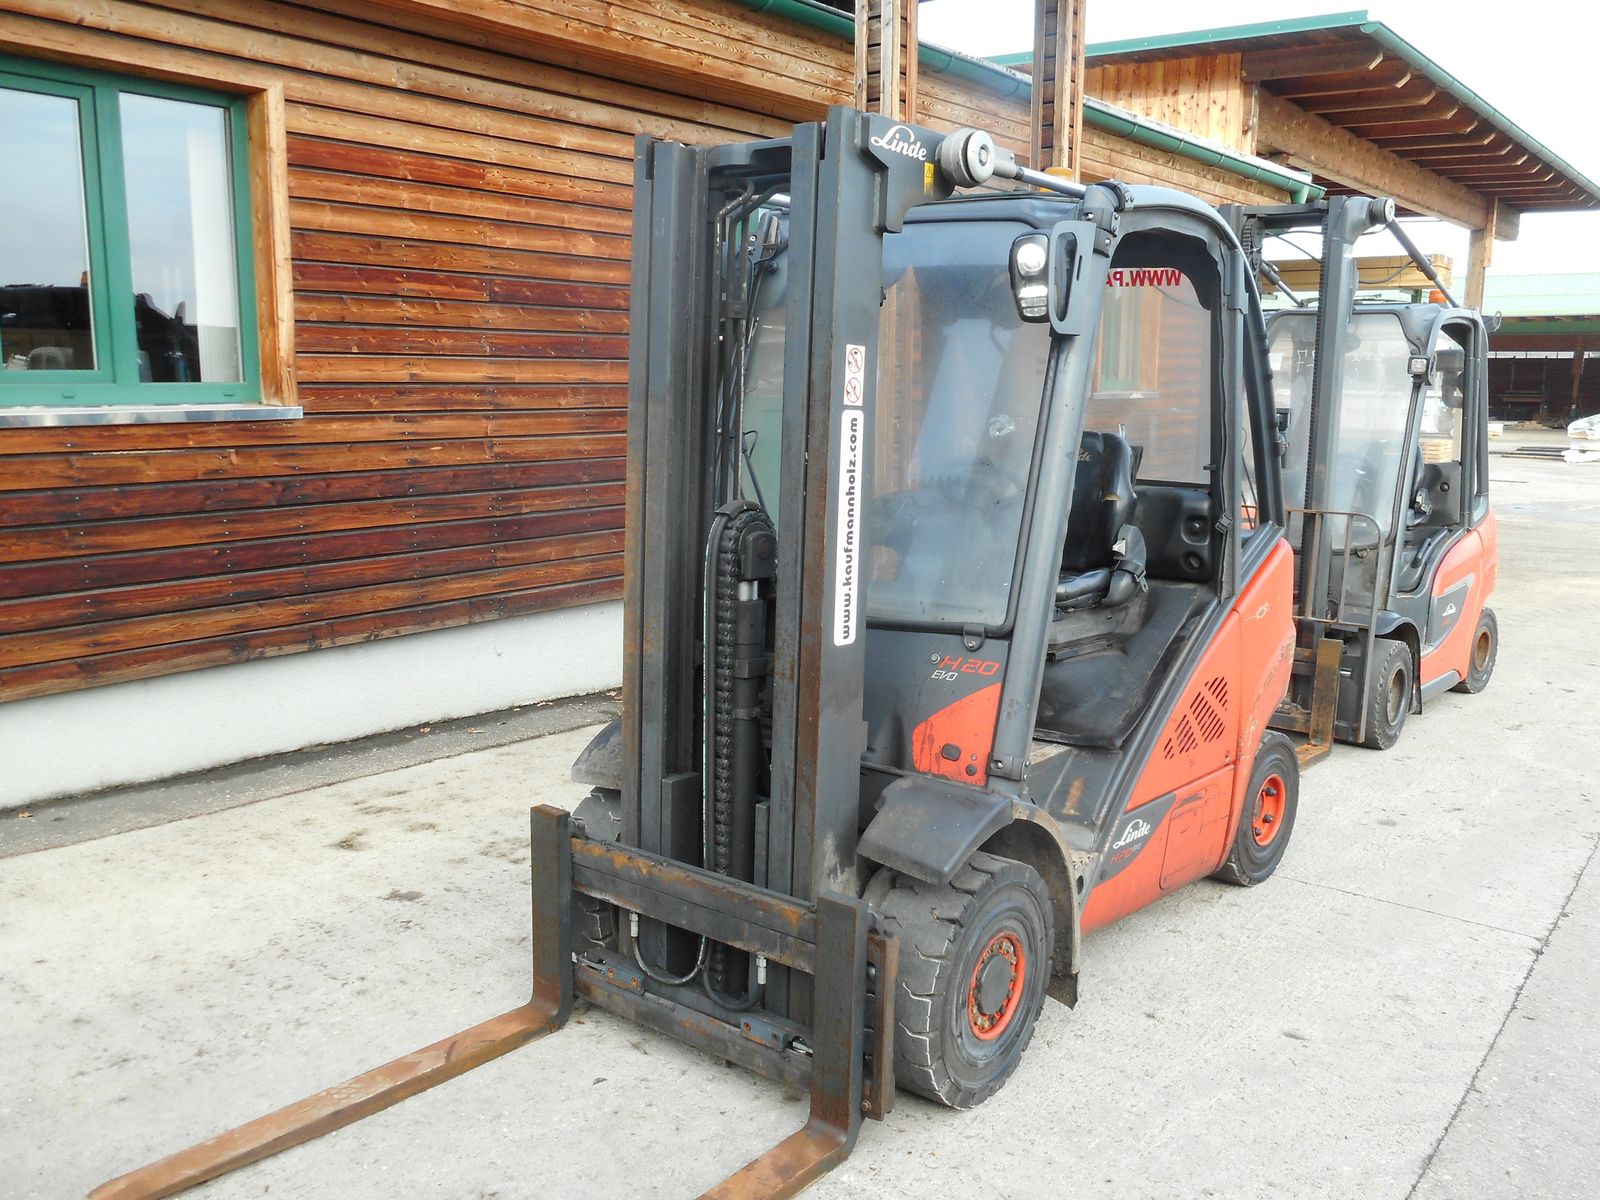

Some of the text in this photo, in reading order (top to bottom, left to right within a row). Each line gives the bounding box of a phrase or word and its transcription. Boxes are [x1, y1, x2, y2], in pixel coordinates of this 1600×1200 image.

[870, 125, 927, 161] Linde
[842, 417, 858, 640] www.kaufmannholz.com
[931, 669, 958, 681] EVO
[1112, 818, 1151, 849] Linde
